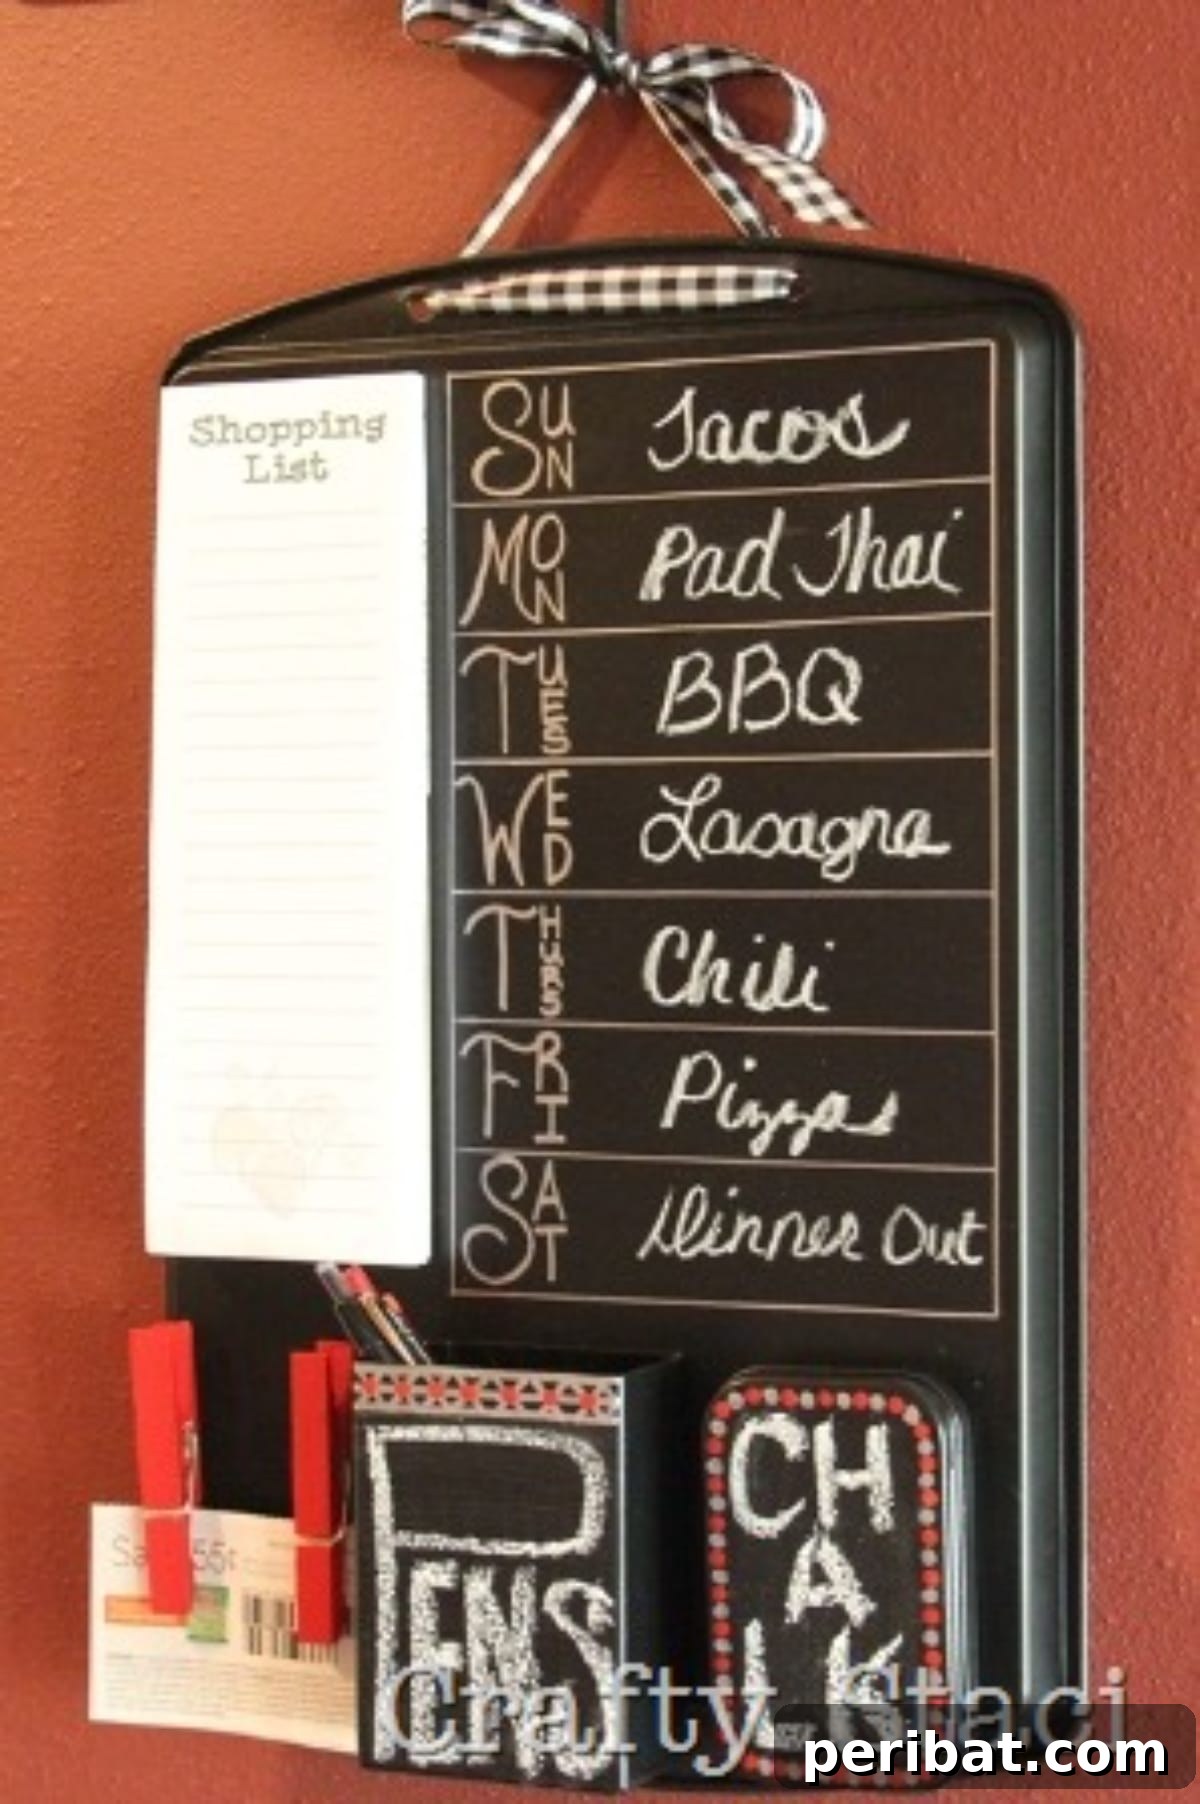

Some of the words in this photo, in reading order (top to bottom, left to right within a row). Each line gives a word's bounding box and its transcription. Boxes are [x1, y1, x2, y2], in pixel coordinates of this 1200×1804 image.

[188, 410, 387, 448] Shopping
[243, 451, 329, 484] List
[647, 386, 910, 472] Tacos
[638, 506, 787, 602] Pad
[793, 505, 963, 598] Thai
[656, 642, 863, 736] BBQ
[639, 773, 952, 882] Lasagna
[641, 924, 836, 1013] Chili
[636, 1183, 863, 1261] Dinner
[882, 1203, 987, 1267] Out
